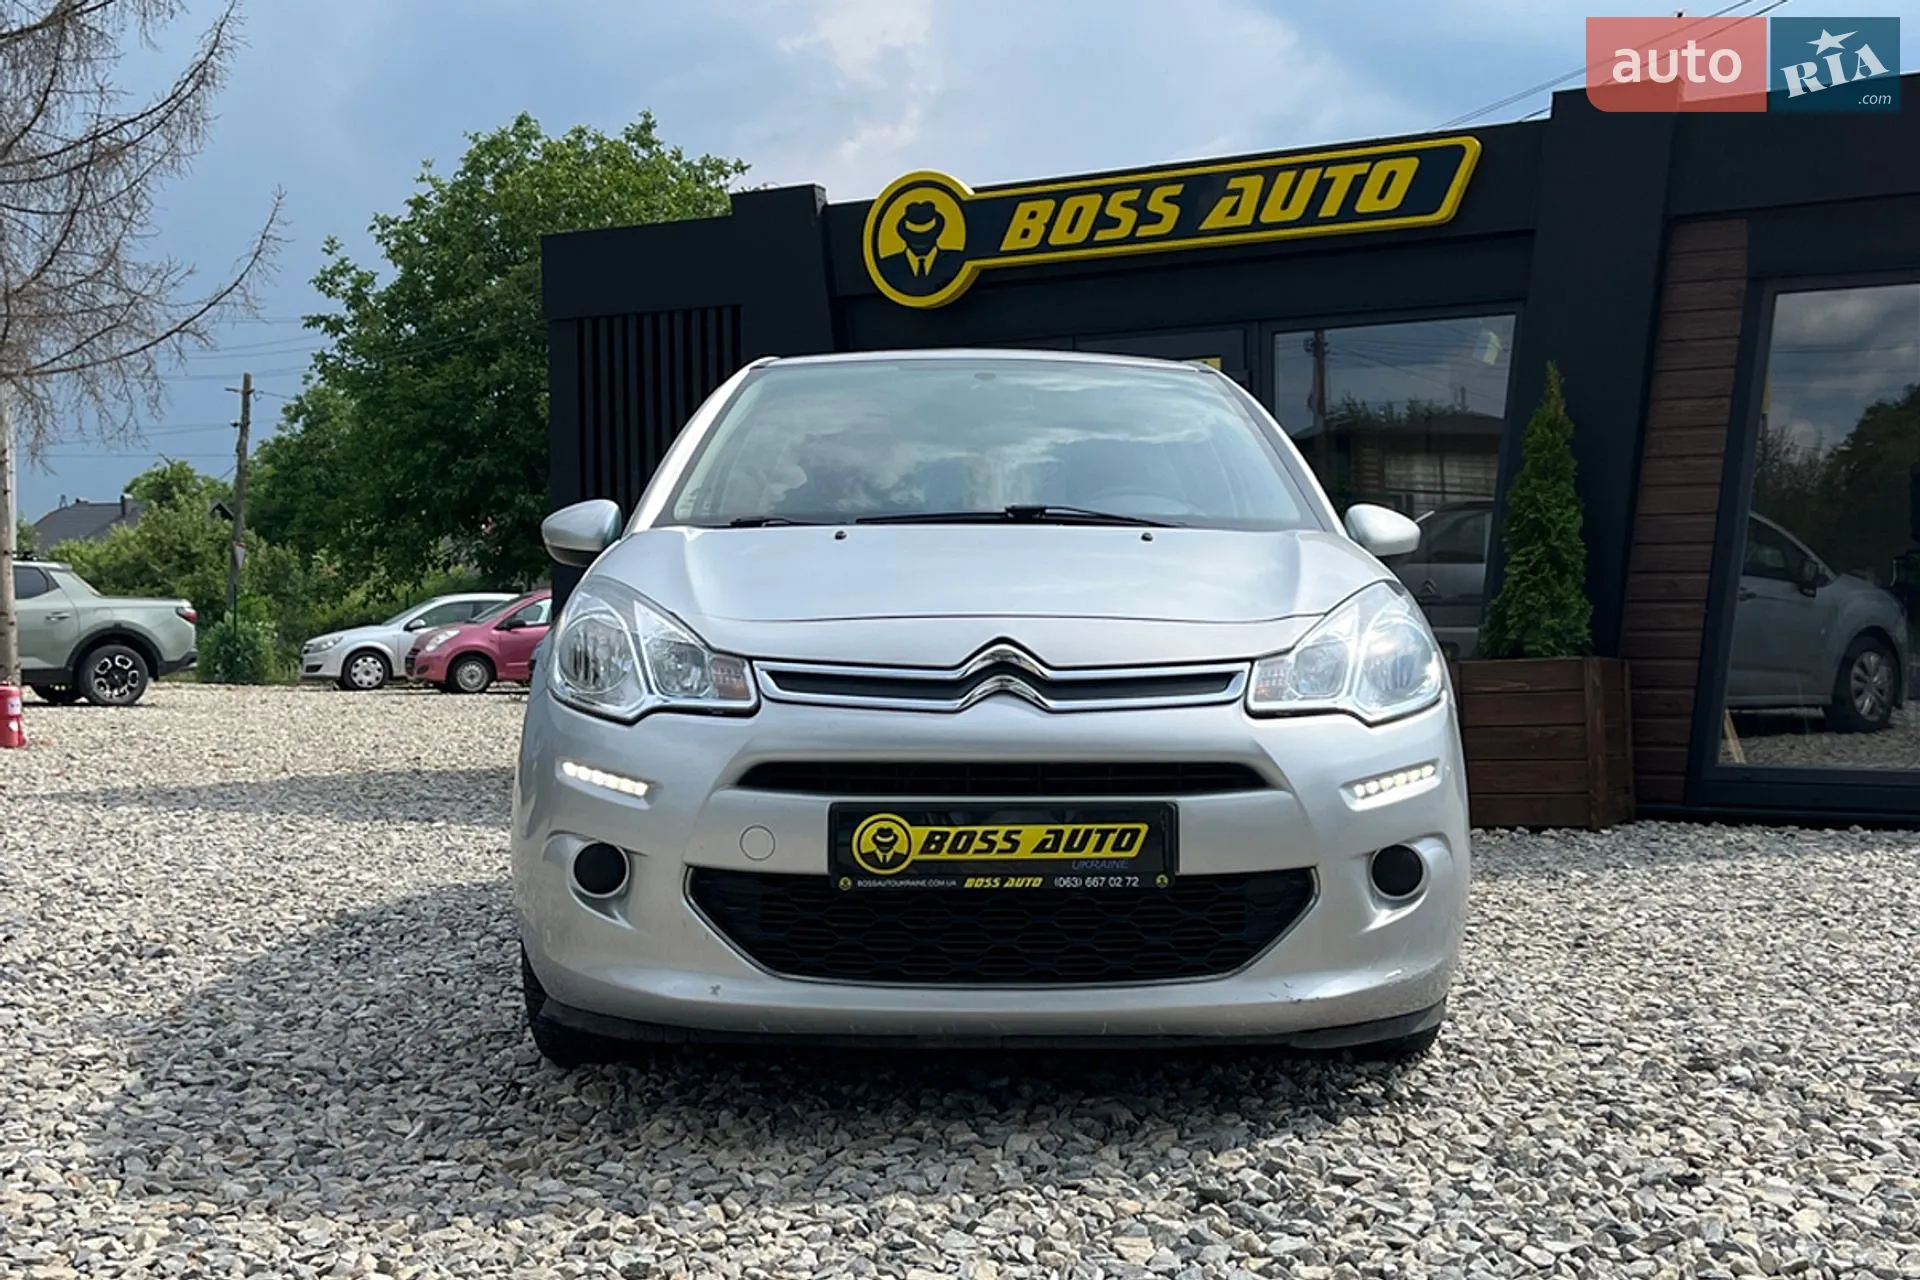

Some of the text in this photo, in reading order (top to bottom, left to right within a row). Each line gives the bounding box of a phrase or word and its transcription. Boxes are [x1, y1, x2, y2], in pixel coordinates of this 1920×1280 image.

[1000, 156, 1421, 251] BOSS AUTO
[919, 827, 1142, 856] BOSS AUTO
[1071, 859, 1129, 870] UKRAINE
[964, 876, 1043, 889] BOSS AUTO
[1054, 876, 1140, 888] (063) 667 02 72
